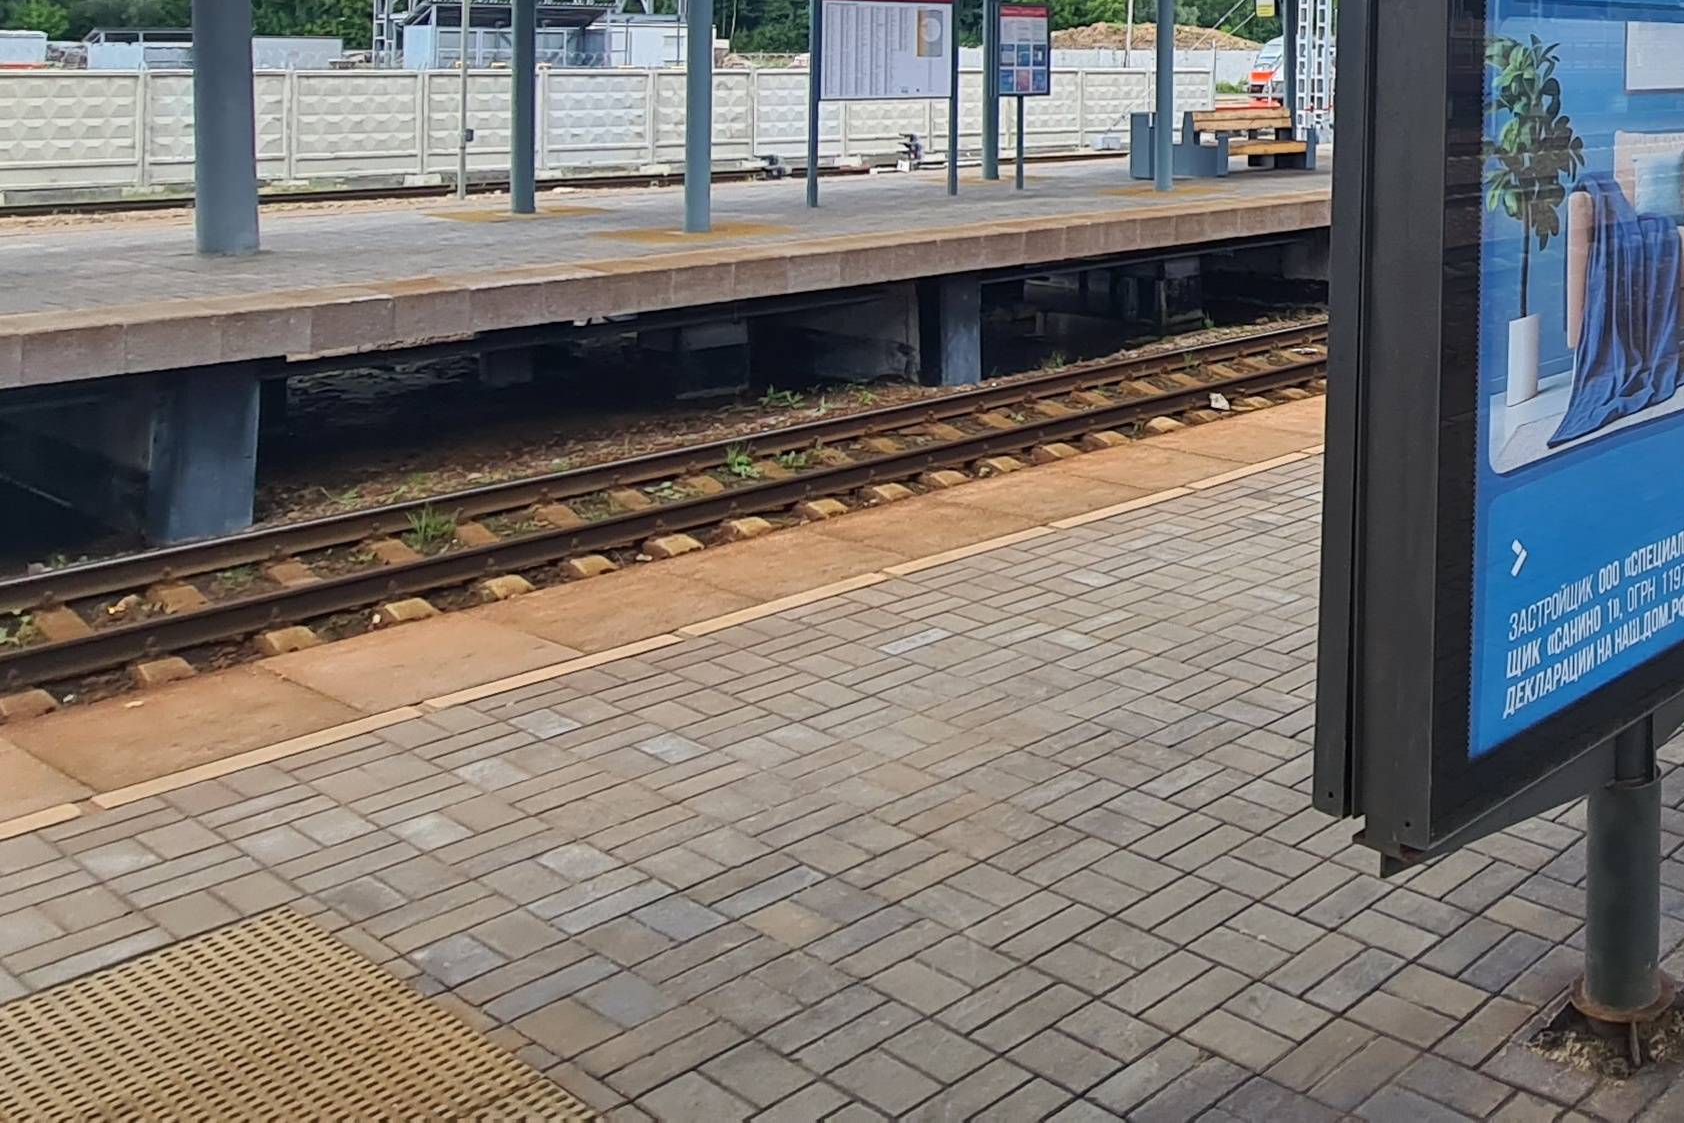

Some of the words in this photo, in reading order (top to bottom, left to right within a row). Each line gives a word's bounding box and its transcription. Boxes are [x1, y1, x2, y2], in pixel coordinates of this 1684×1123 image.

[1506, 637, 1542, 679] ЩИК
[1547, 604, 1601, 656] «САНИНО
[1627, 576, 1656, 613] ОГРН
[1508, 573, 1594, 641] ЗАСТРОЙЩИК
[1598, 560, 1620, 594] ООО
[1502, 643, 1595, 720] ДЕКЛАРАЦИИ
[1596, 633, 1612, 666] НА
